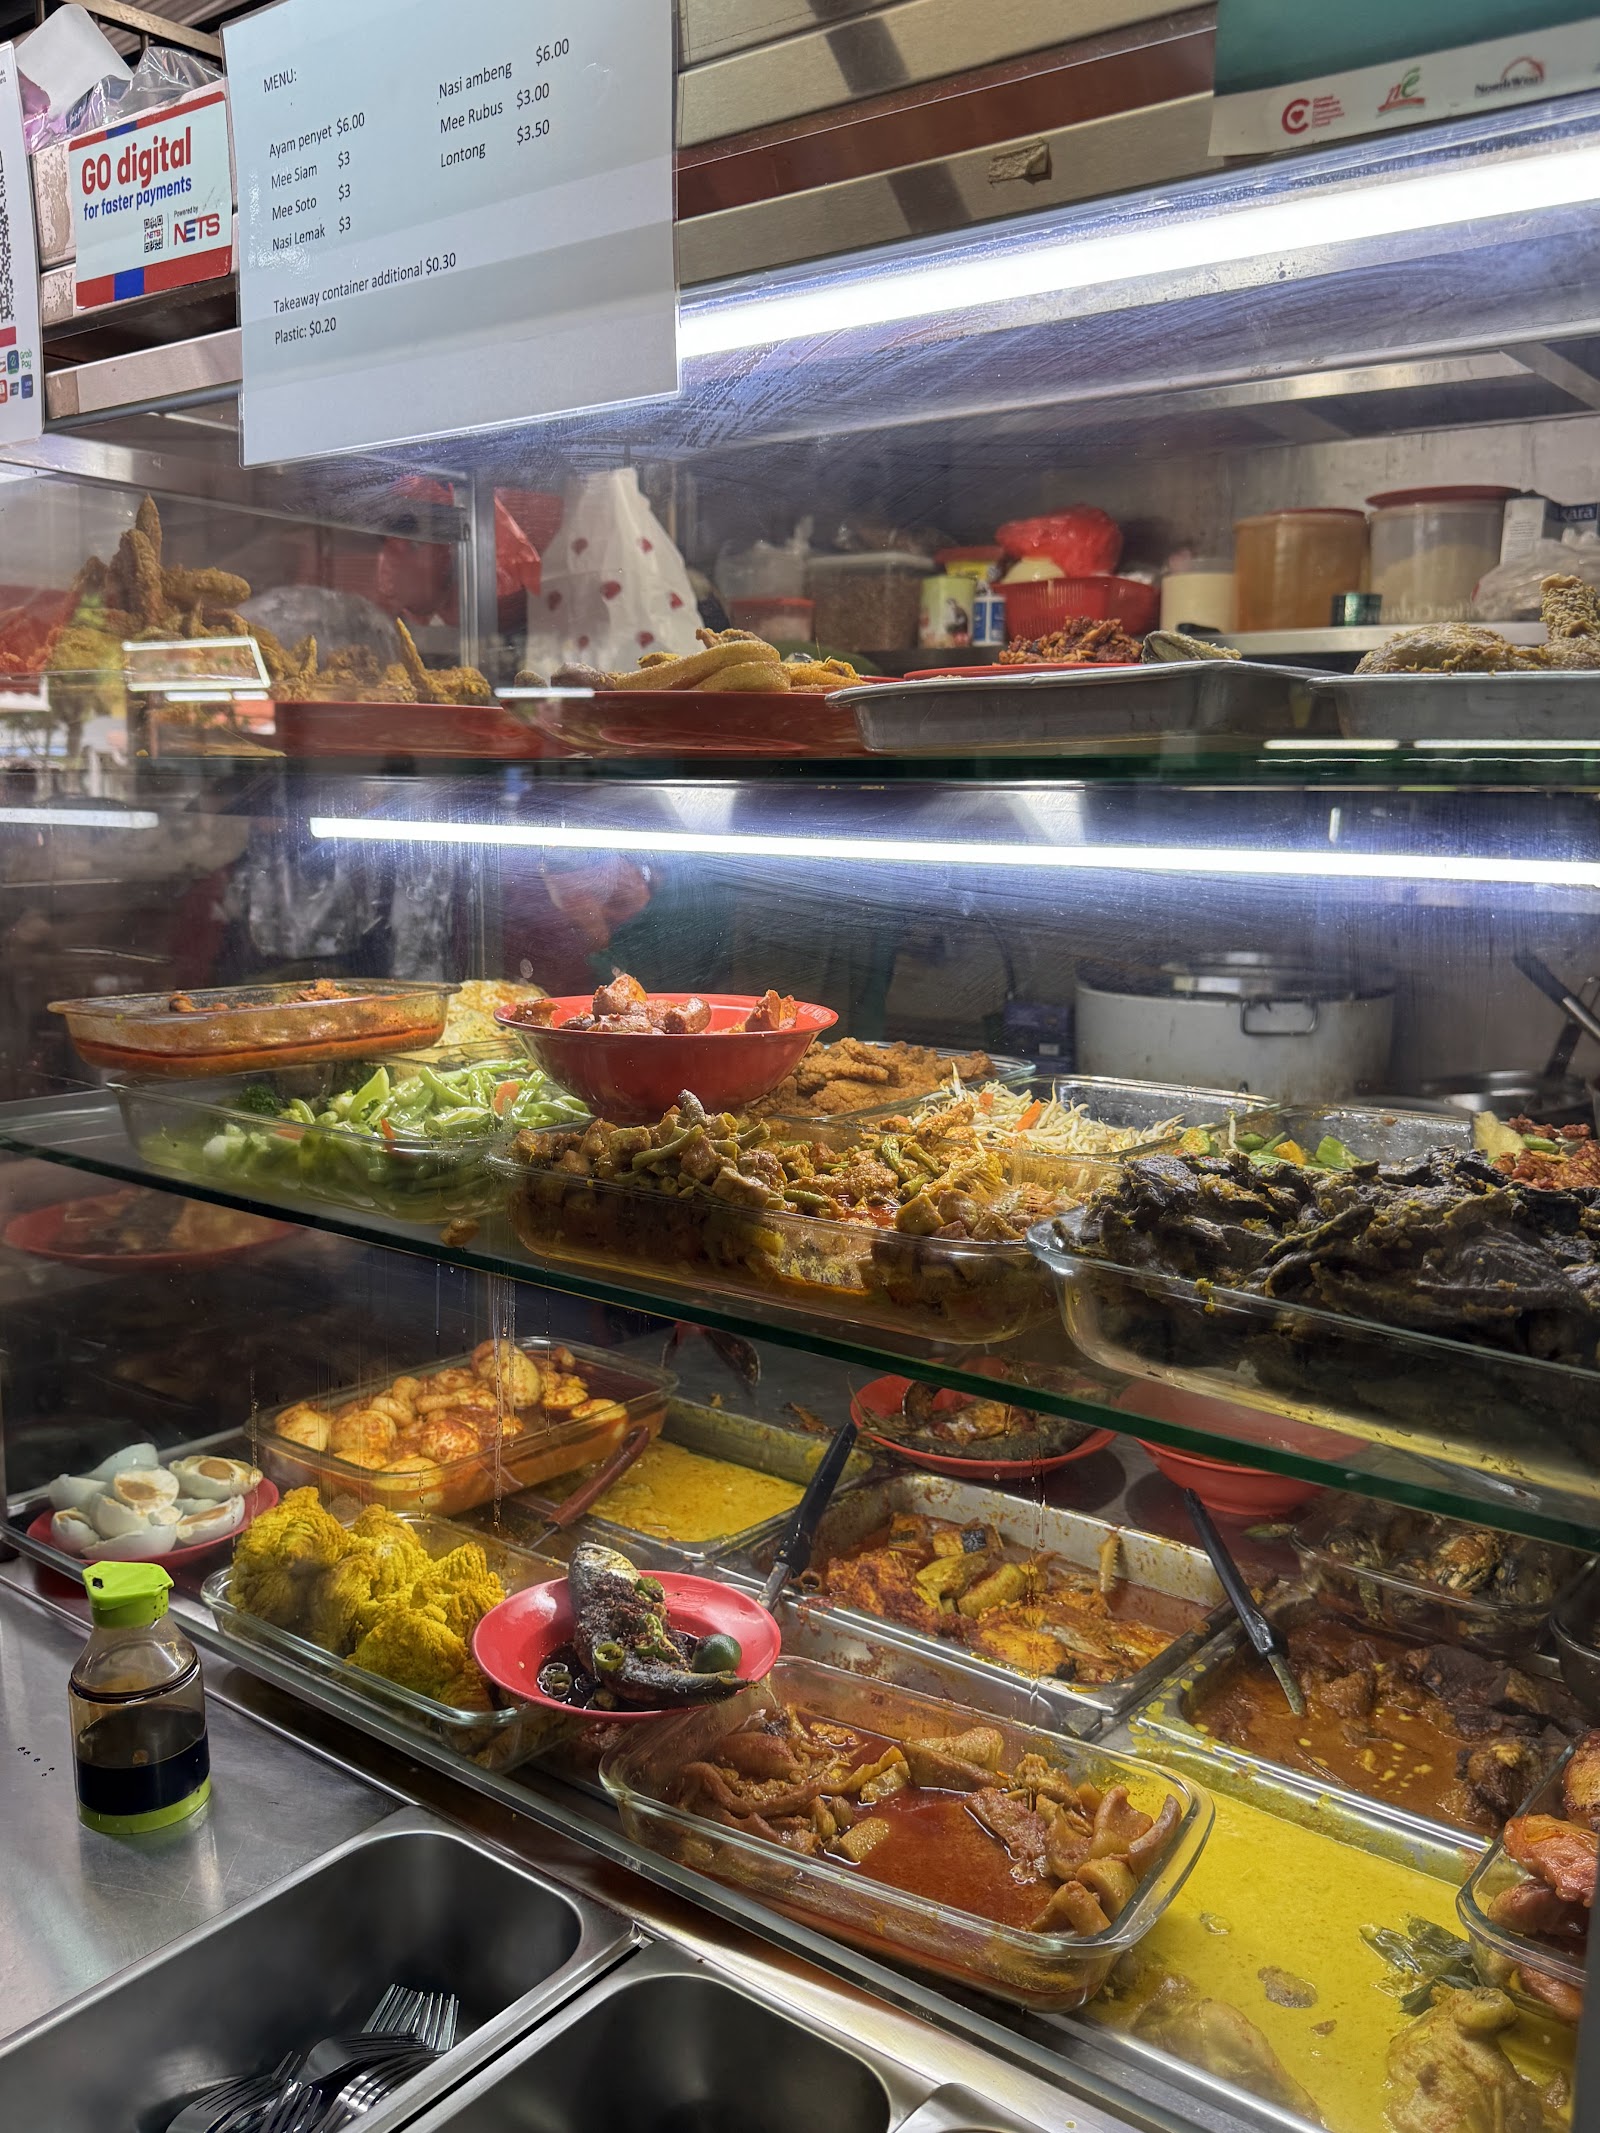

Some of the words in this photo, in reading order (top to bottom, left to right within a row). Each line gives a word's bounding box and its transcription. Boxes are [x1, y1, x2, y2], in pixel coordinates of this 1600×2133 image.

[263, 68, 297, 93] MENU:
[439, 76, 463, 99] Nasi
[465, 62, 512, 89] ambeng
[536, 38, 570, 67] $6.00
[440, 114, 465, 134] Mee
[468, 101, 503, 124] Rubus
[516, 82, 550, 110] $3.00
[269, 139, 296, 159] Ayam
[298, 124, 332, 151] penyet
[336, 112, 365, 136] $6.00
[440, 143, 486, 168] Lontong
[516, 119, 550, 146] $3.50
[82, 153, 111, 195] GO
[117, 126, 192, 188] digital
[271, 173, 292, 189] Mee
[294, 165, 318, 182] Siam
[337, 151, 351, 169] $3
[84, 203, 99, 221] for
[101, 194, 134, 216] faster
[136, 175, 192, 210] payments
[173, 206, 193, 218] Powered
[193, 205, 199, 214] by
[272, 205, 293, 221] Mee
[295, 197, 317, 214] Soto
[338, 184, 351, 202] $3
[173, 213, 220, 246] NETS
[272, 233, 292, 251] Nasi
[294, 223, 326, 245] Lemak
[338, 216, 351, 234] $3
[273, 291, 320, 314] Takeaway
[322, 277, 369, 301] container
[371, 260, 423, 288] additional
[425, 252, 457, 276] $0.30
[275, 326, 307, 345] Plastic:
[309, 317, 337, 338] $0.20
